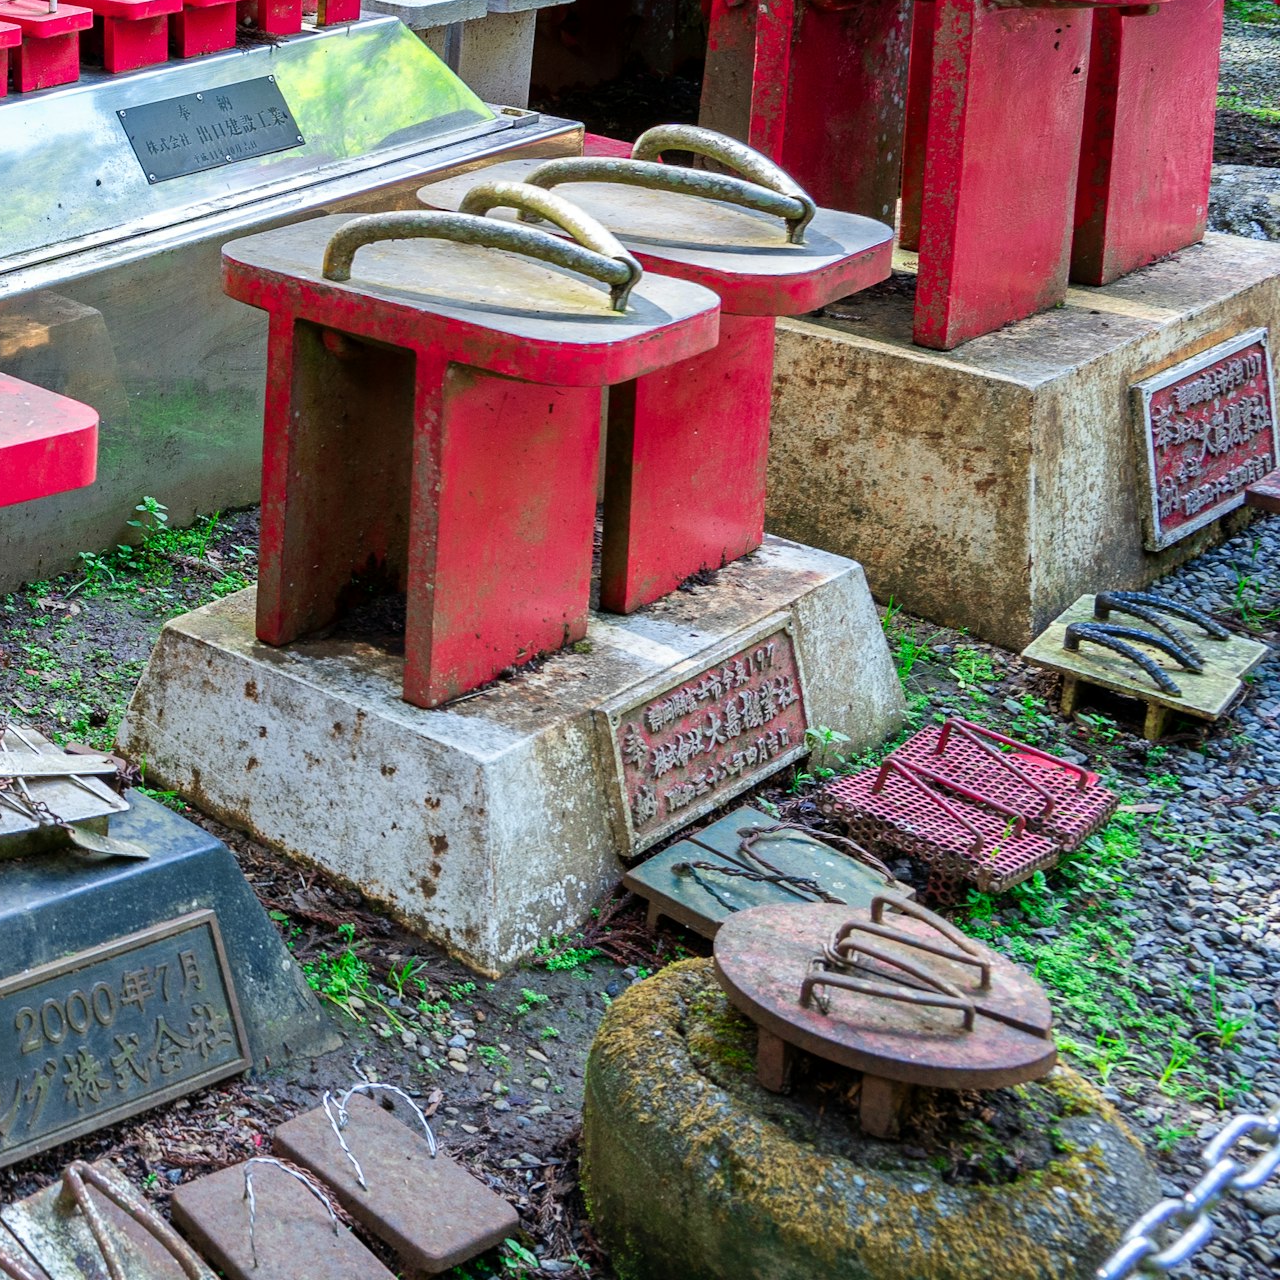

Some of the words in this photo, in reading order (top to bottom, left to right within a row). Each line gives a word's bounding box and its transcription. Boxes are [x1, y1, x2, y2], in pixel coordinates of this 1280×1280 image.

[145, 132, 192, 156] 株式会社
[195, 106, 286, 144] 出口建設工業
[15, 948, 206, 1056] 2000年7月
